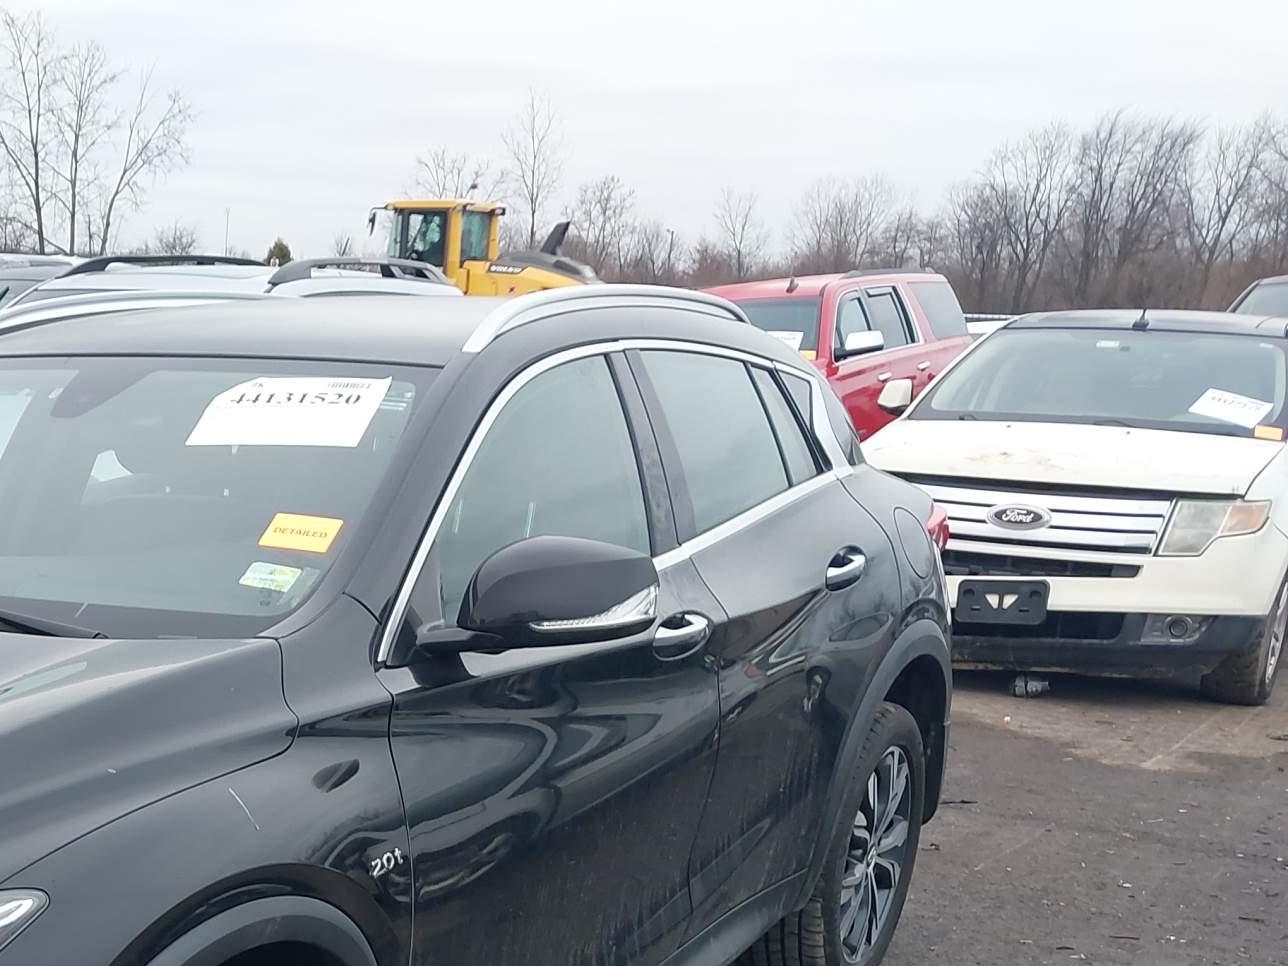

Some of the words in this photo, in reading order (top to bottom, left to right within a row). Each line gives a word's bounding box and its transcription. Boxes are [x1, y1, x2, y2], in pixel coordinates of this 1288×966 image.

[230, 392, 362, 405] 44131520
[1001, 508, 1035, 523] Ford
[273, 525, 329, 539] DETAILED
